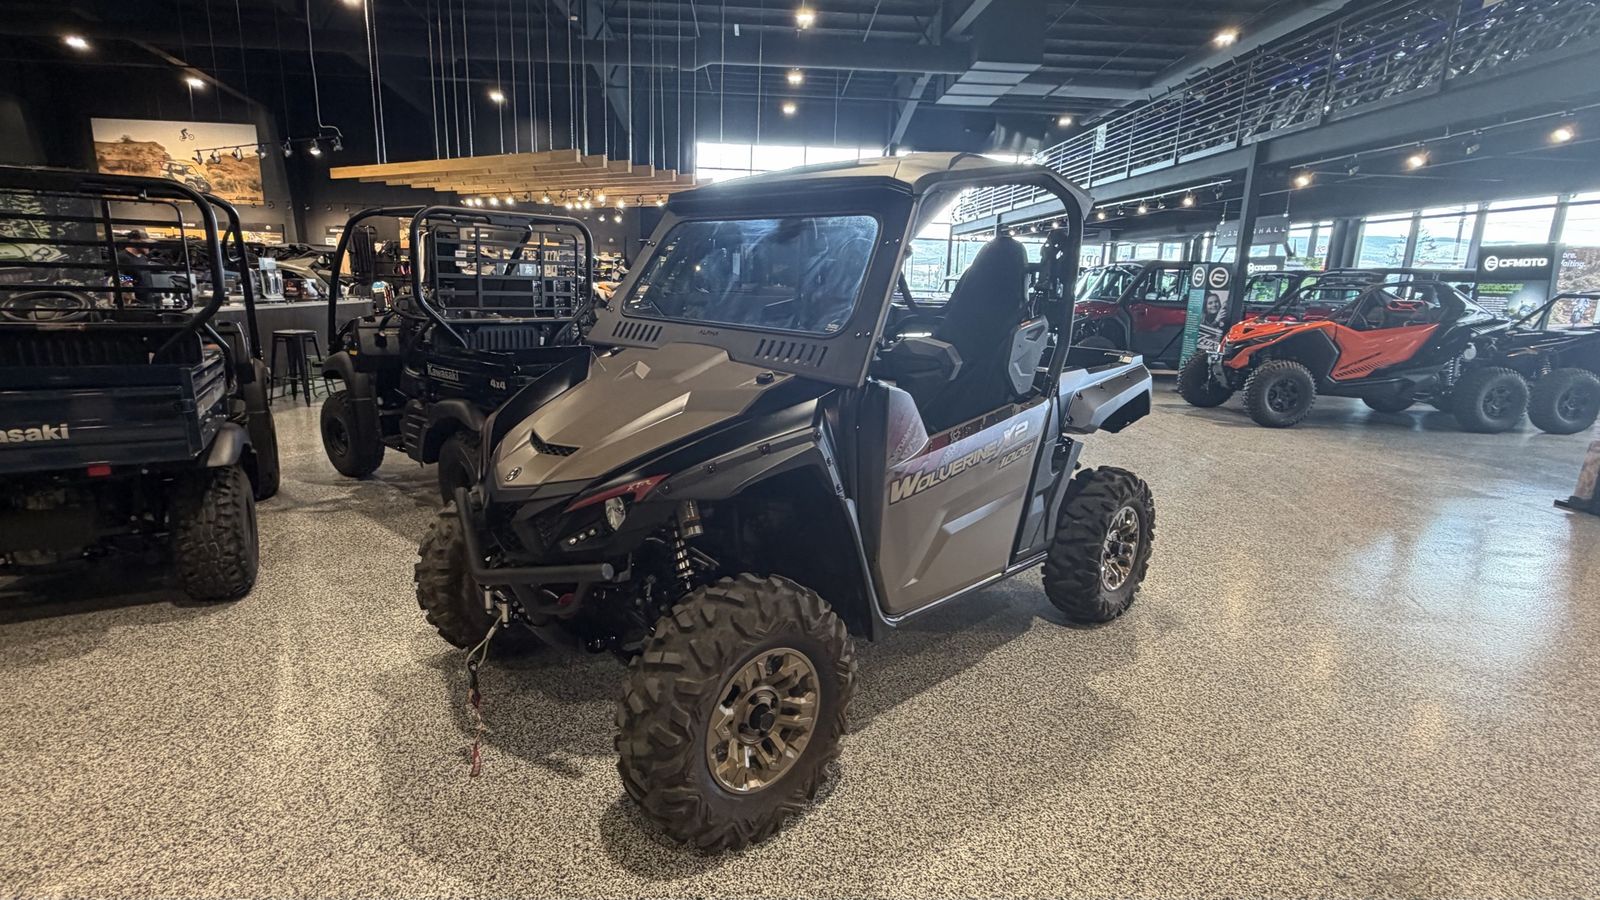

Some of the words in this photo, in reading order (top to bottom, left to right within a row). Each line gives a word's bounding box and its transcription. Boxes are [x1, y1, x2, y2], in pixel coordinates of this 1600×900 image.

[1498, 258, 1548, 267] CFMOTO
[427, 363, 459, 381] Kawasaki
[490, 379, 506, 391] 4x4
[1003, 420, 1029, 446] X2
[1000, 441, 1033, 468] 1000
